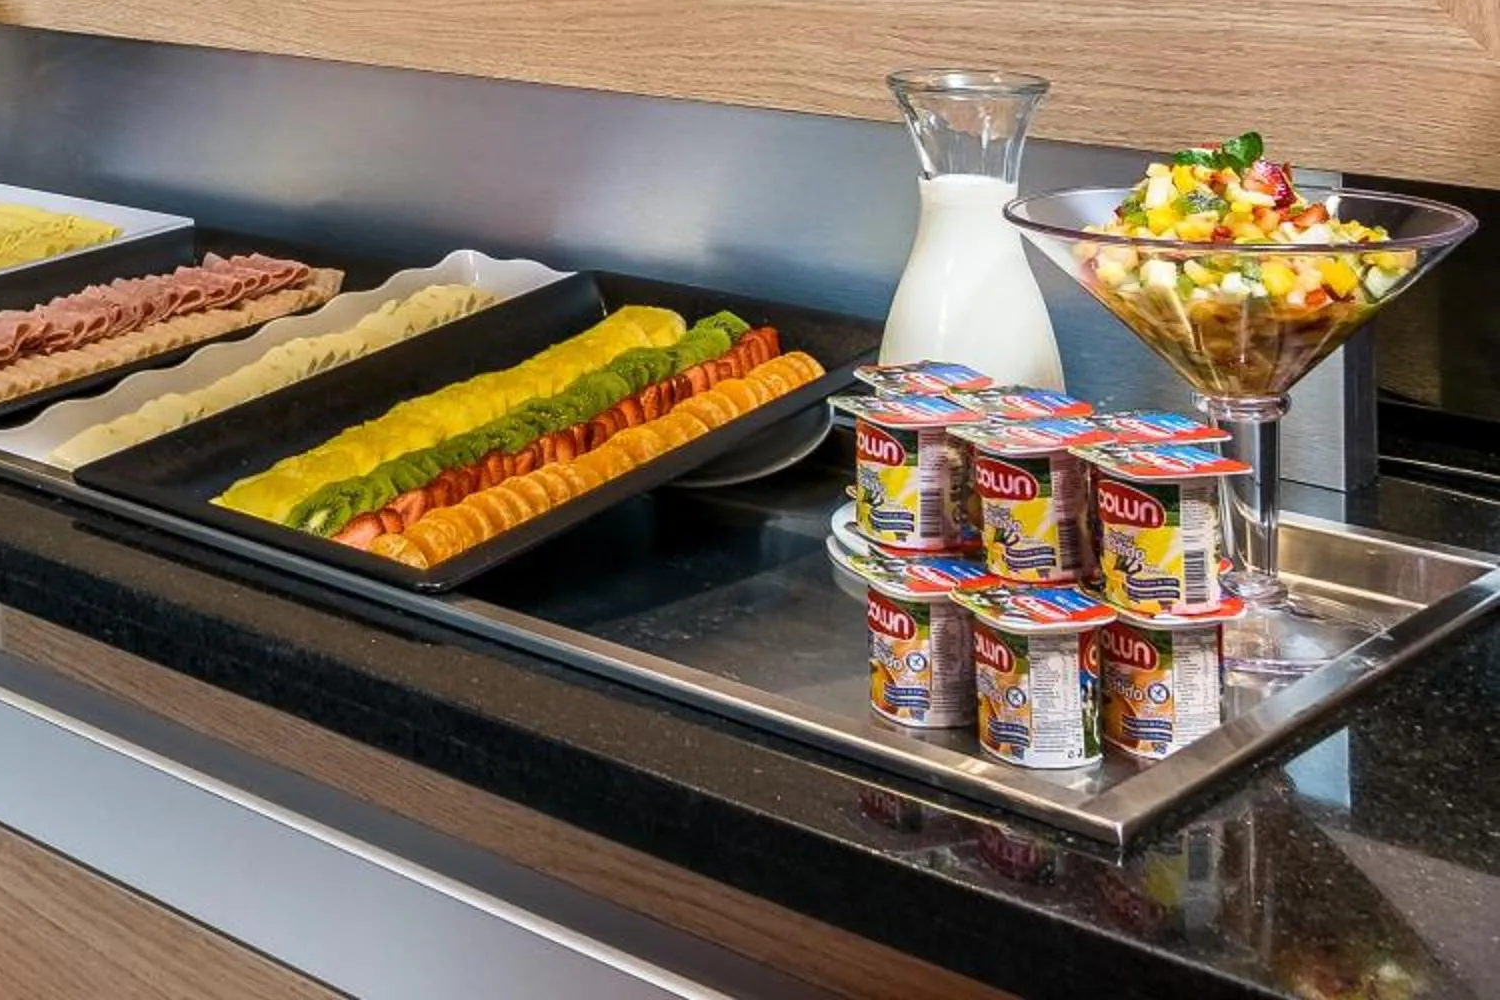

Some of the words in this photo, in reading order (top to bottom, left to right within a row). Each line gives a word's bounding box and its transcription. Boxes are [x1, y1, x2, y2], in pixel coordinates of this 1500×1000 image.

[856, 431, 900, 463] OLUN
[867, 599, 910, 638] OLUN
[1100, 629, 1152, 668] OLUN
